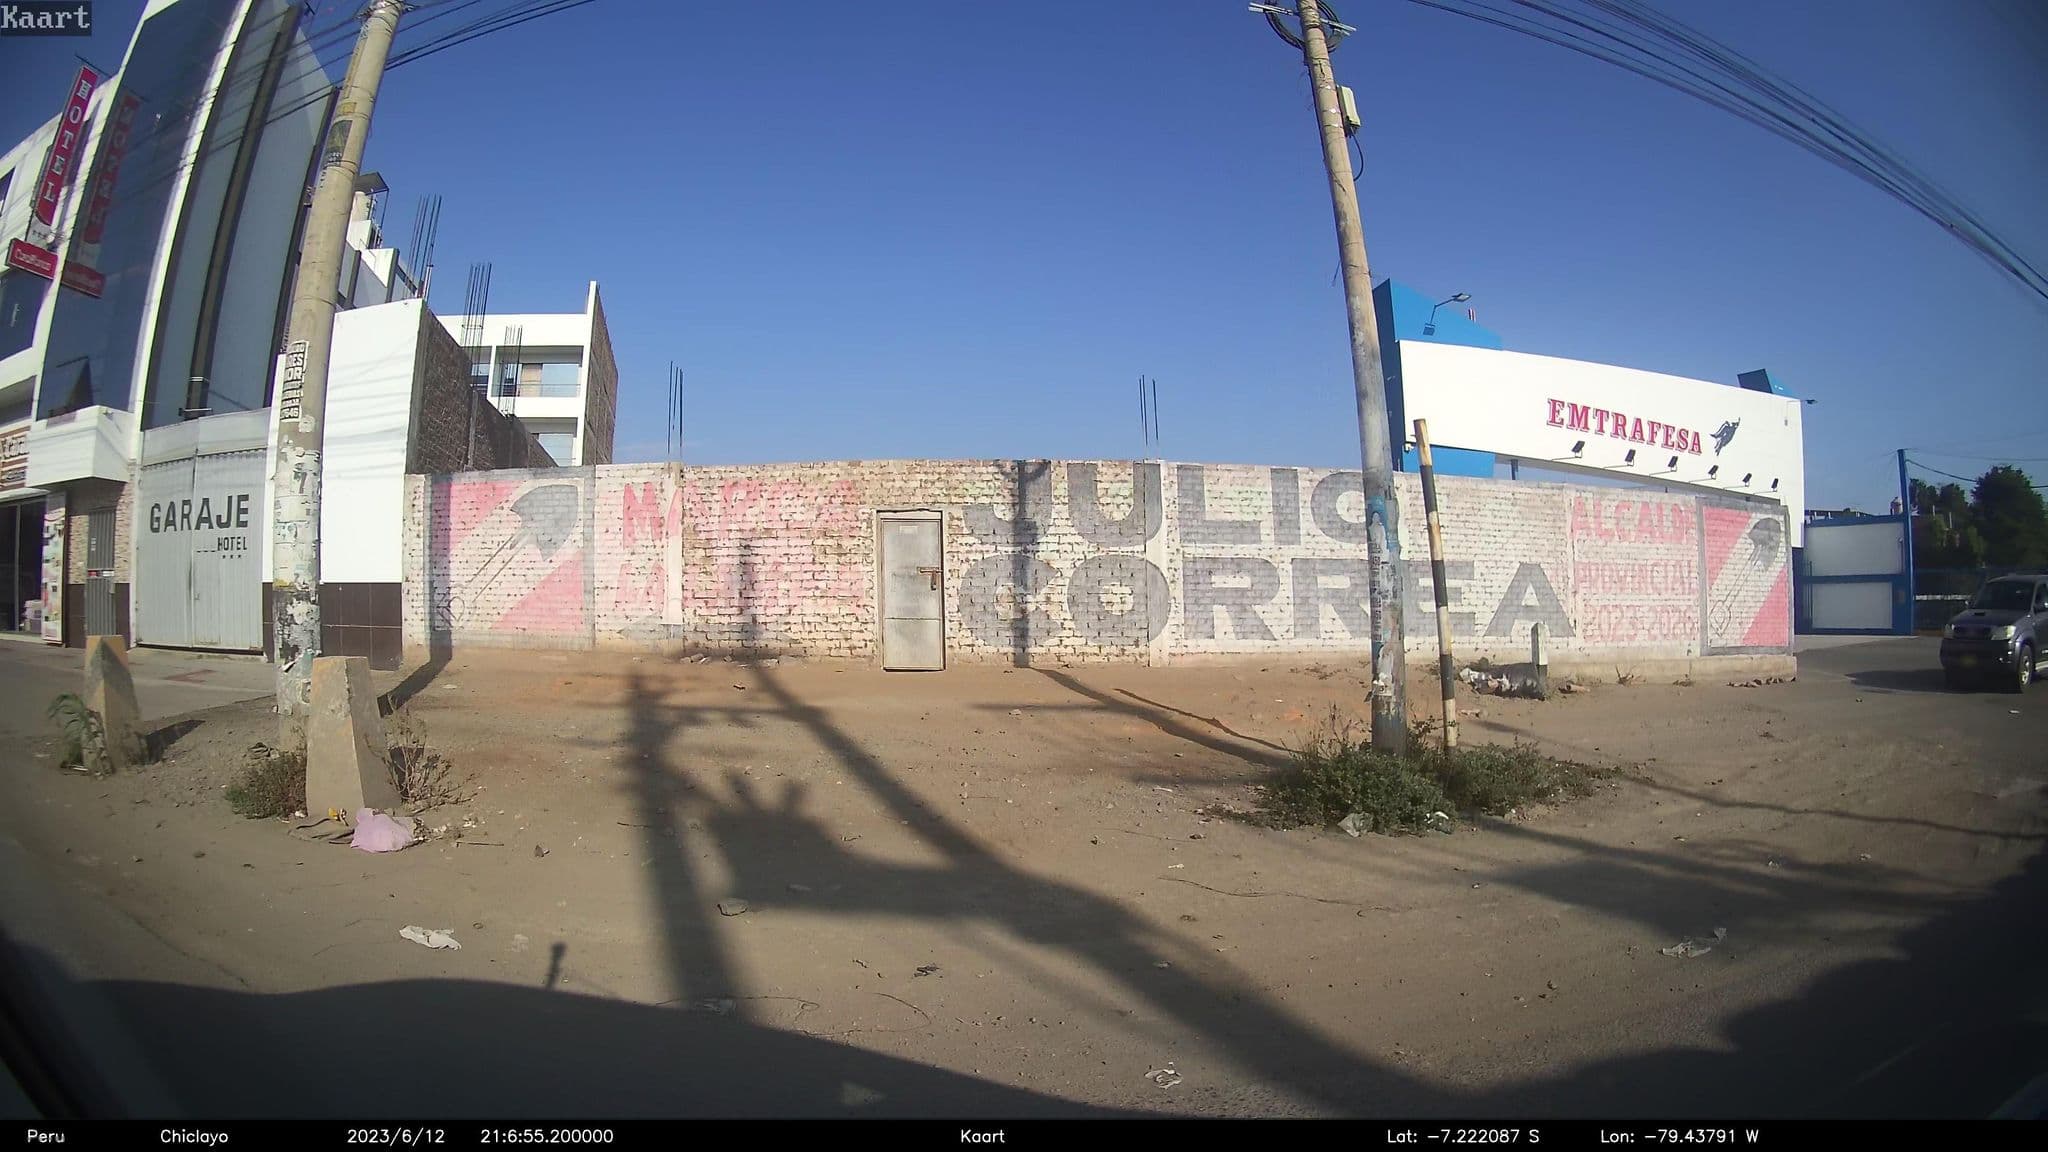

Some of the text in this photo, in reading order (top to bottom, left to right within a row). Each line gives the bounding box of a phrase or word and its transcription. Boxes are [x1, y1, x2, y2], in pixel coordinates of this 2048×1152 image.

[44, 80, 92, 202] HOTEL
[1547, 398, 1703, 456] EMTRAFESA
[149, 494, 250, 534] GARAJE
[217, 536, 248, 552] HOTEL
[957, 552, 1578, 643] CORREA
[1574, 559, 1698, 594] PROVINCIAL
